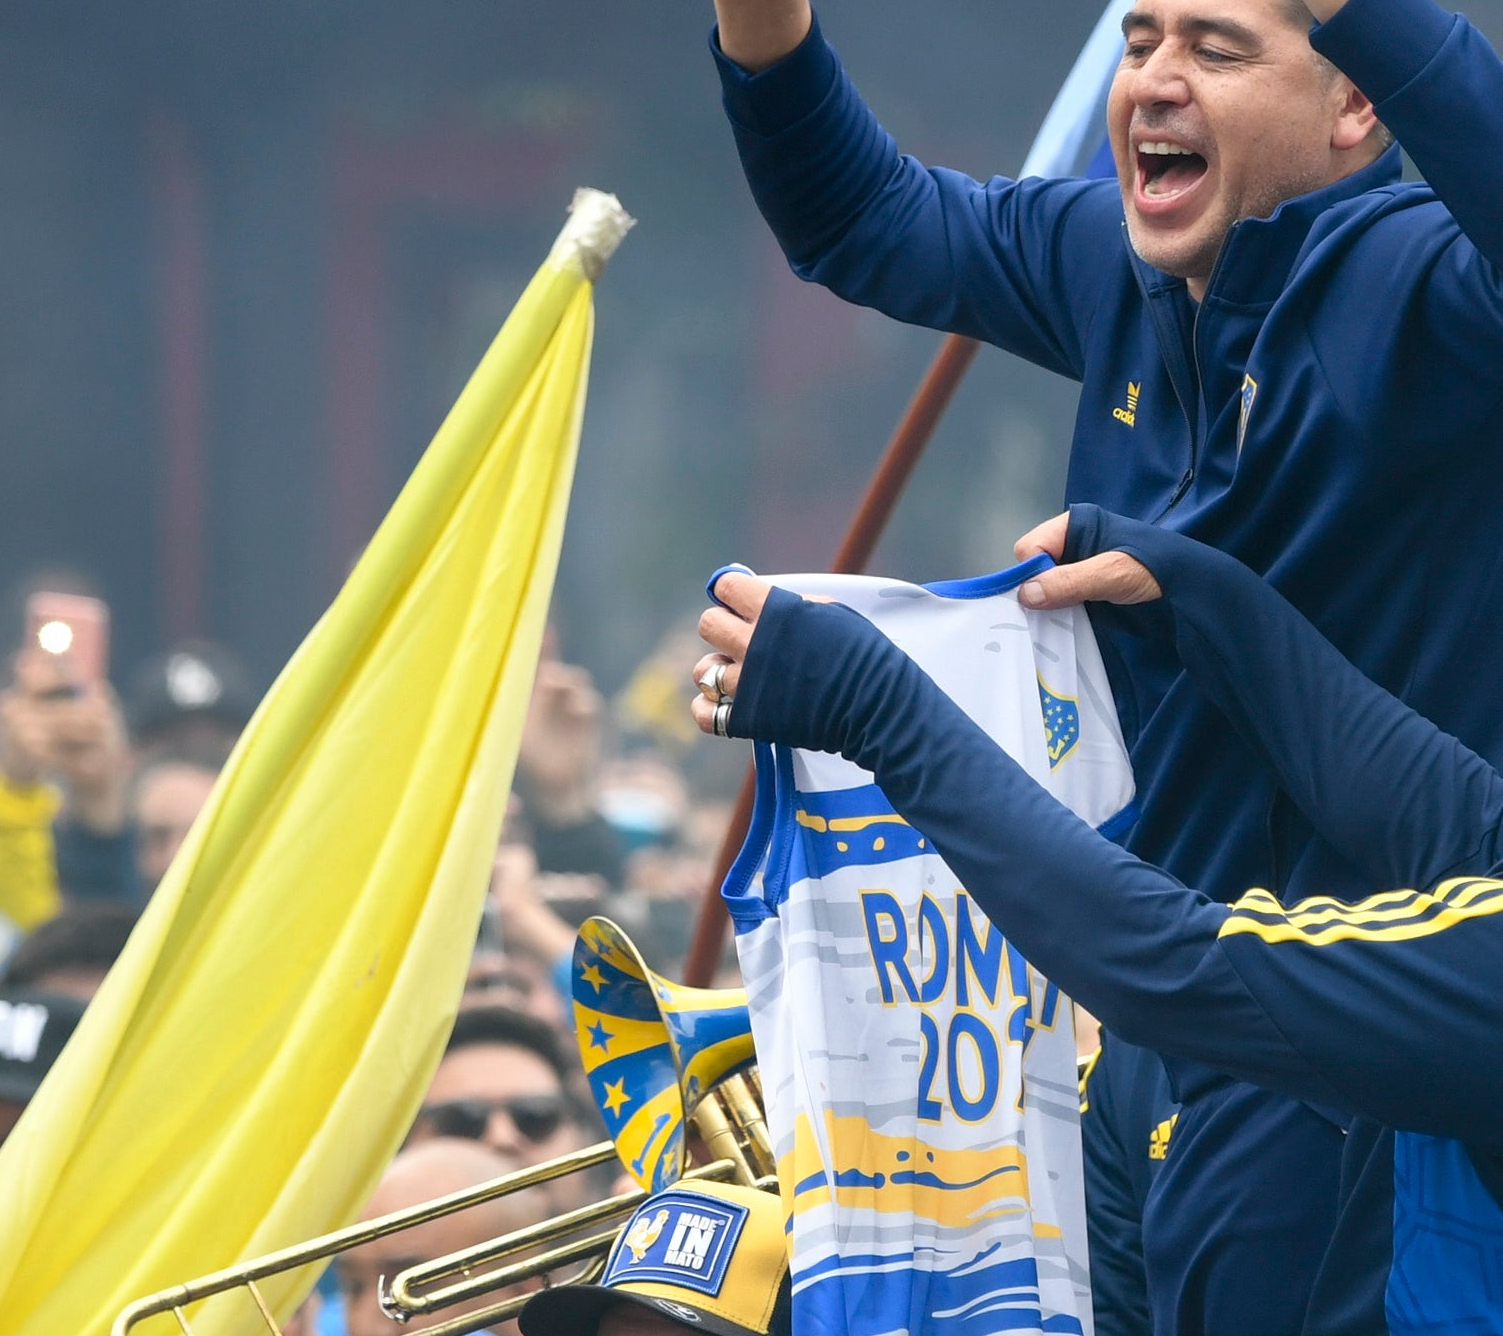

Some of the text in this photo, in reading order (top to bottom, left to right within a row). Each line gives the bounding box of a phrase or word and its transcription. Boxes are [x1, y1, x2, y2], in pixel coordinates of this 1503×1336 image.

[858, 888, 1064, 1033] ROM
[677, 1212, 718, 1232] MADE
[667, 1224, 715, 1258] IN
[663, 1249, 705, 1270] MATO
